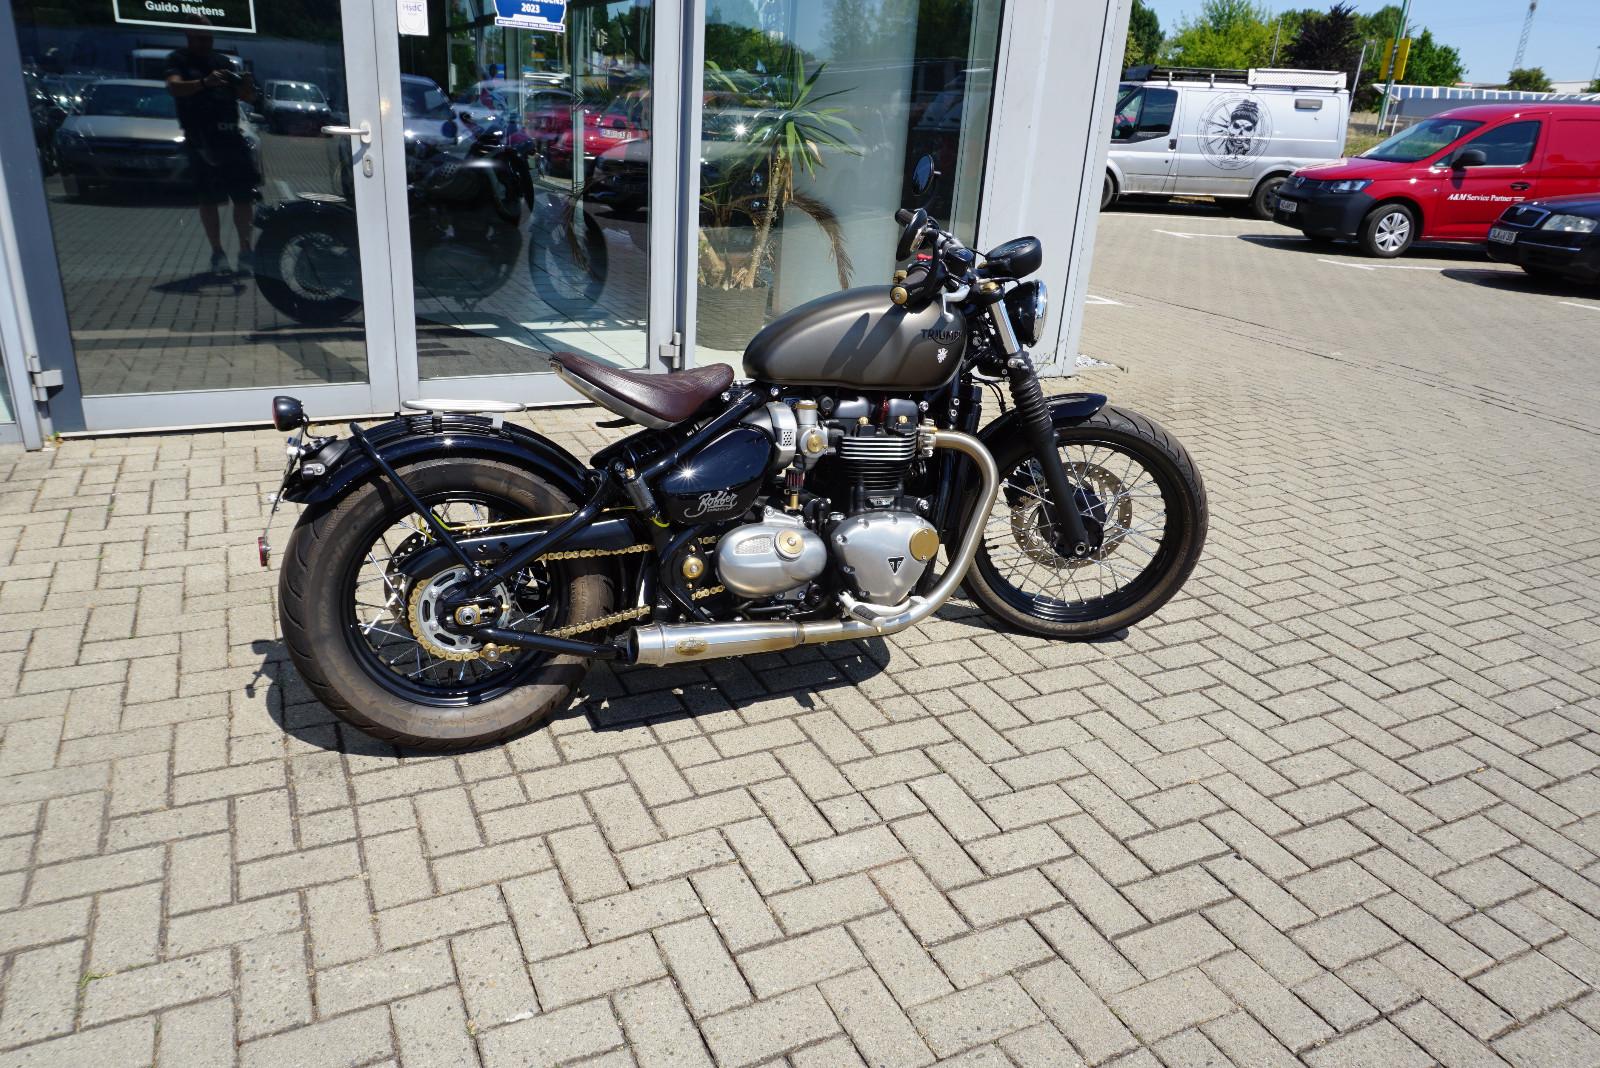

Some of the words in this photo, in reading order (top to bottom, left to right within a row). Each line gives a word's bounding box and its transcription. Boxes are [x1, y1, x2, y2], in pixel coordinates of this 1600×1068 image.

[144, 1, 180, 13] Guido
[181, 3, 226, 17] Mertens
[521, 2, 541, 13] 2023
[1447, 193, 1467, 201] A&M
[1467, 194, 1490, 202] Service
[1490, 194, 1513, 202] Partner
[921, 328, 962, 341] TRIUMP
